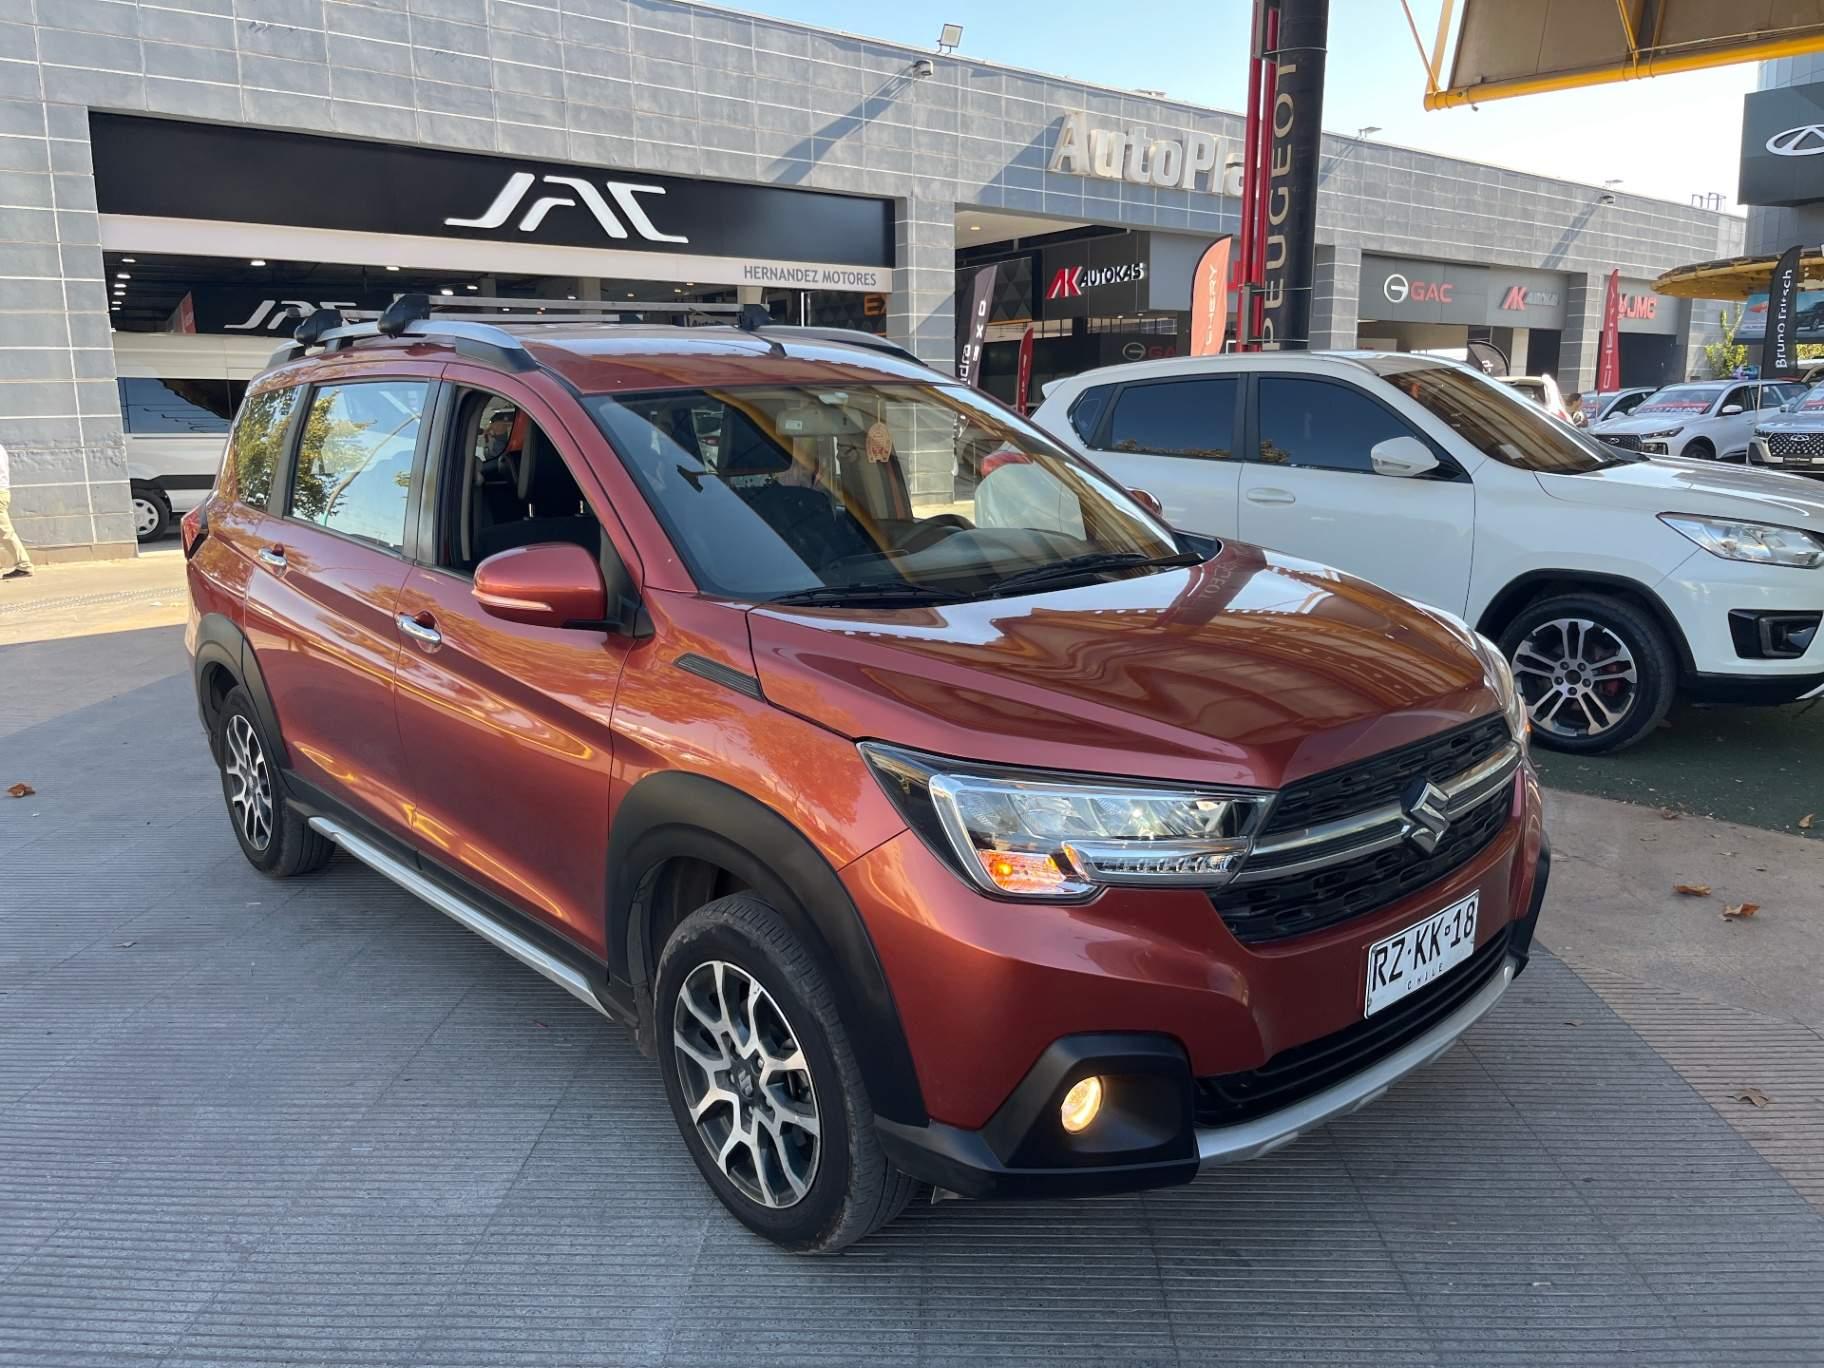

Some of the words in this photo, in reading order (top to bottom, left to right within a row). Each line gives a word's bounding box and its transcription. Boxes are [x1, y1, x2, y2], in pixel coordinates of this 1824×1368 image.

[444, 172, 689, 243] JAC
[1262, 58, 1298, 352] PEUGEOT
[743, 264, 819, 284] HERNANDEZ
[822, 270, 877, 286] MOTORES
[1046, 264, 1083, 300] AK
[1080, 262, 1146, 288] AUTOKAS
[1410, 280, 1455, 304] GAC
[1775, 323, 1787, 369] Bruno
